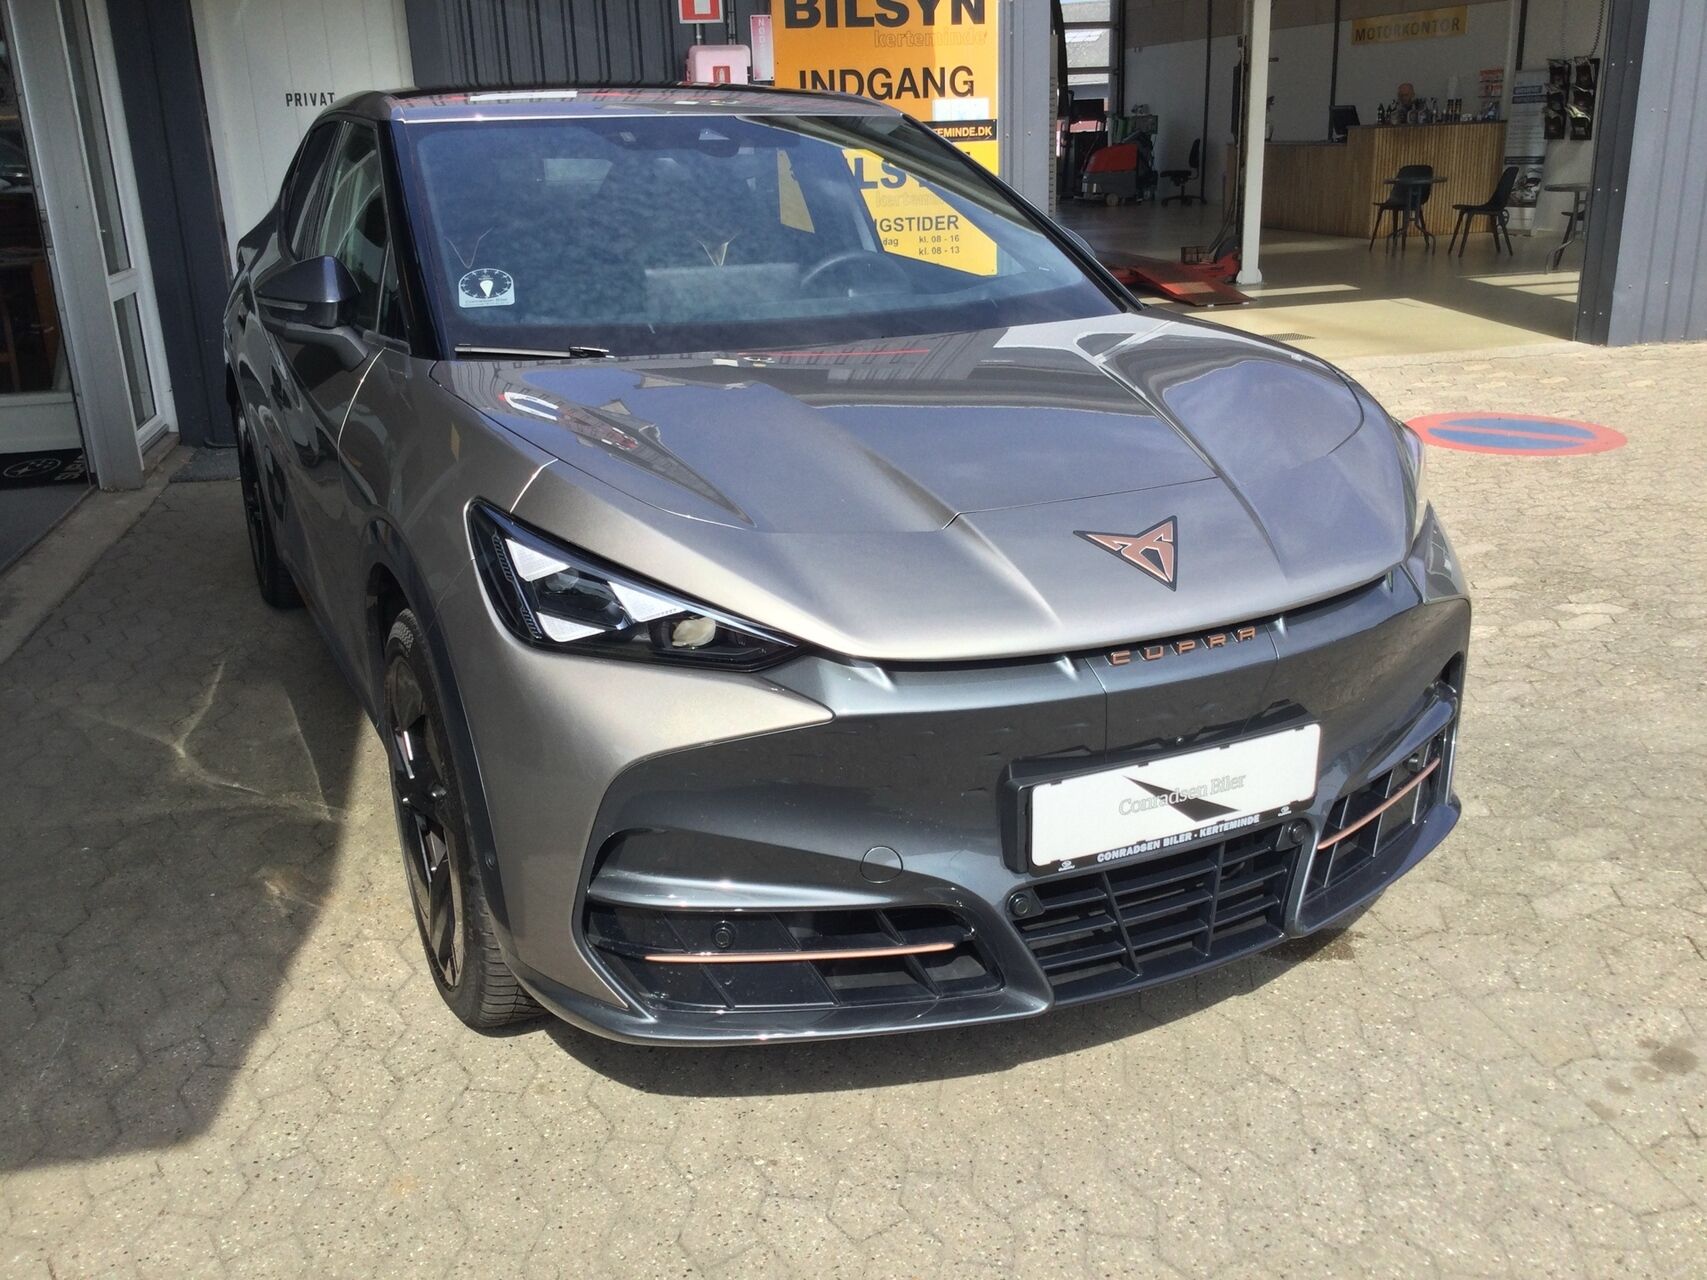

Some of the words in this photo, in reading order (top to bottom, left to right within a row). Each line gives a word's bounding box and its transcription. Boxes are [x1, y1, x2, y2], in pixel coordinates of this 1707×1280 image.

[784, 0, 985, 29] BILSYN
[1355, 17, 1461, 41] MOTORKONTOR
[799, 65, 974, 100] INDGANG
[285, 92, 335, 106] PRIVAT
[875, 215, 959, 233] GSTIDER
[882, 238, 899, 247] dag
[1110, 626, 1256, 666] CUPRA
[1118, 784, 1208, 815] Conradsen
[1210, 775, 1246, 797] Biler
[1097, 839, 1161, 863] CONRADSEN
[1163, 832, 1193, 847] BILER
[1200, 814, 1260, 837] KERTEMINDE
